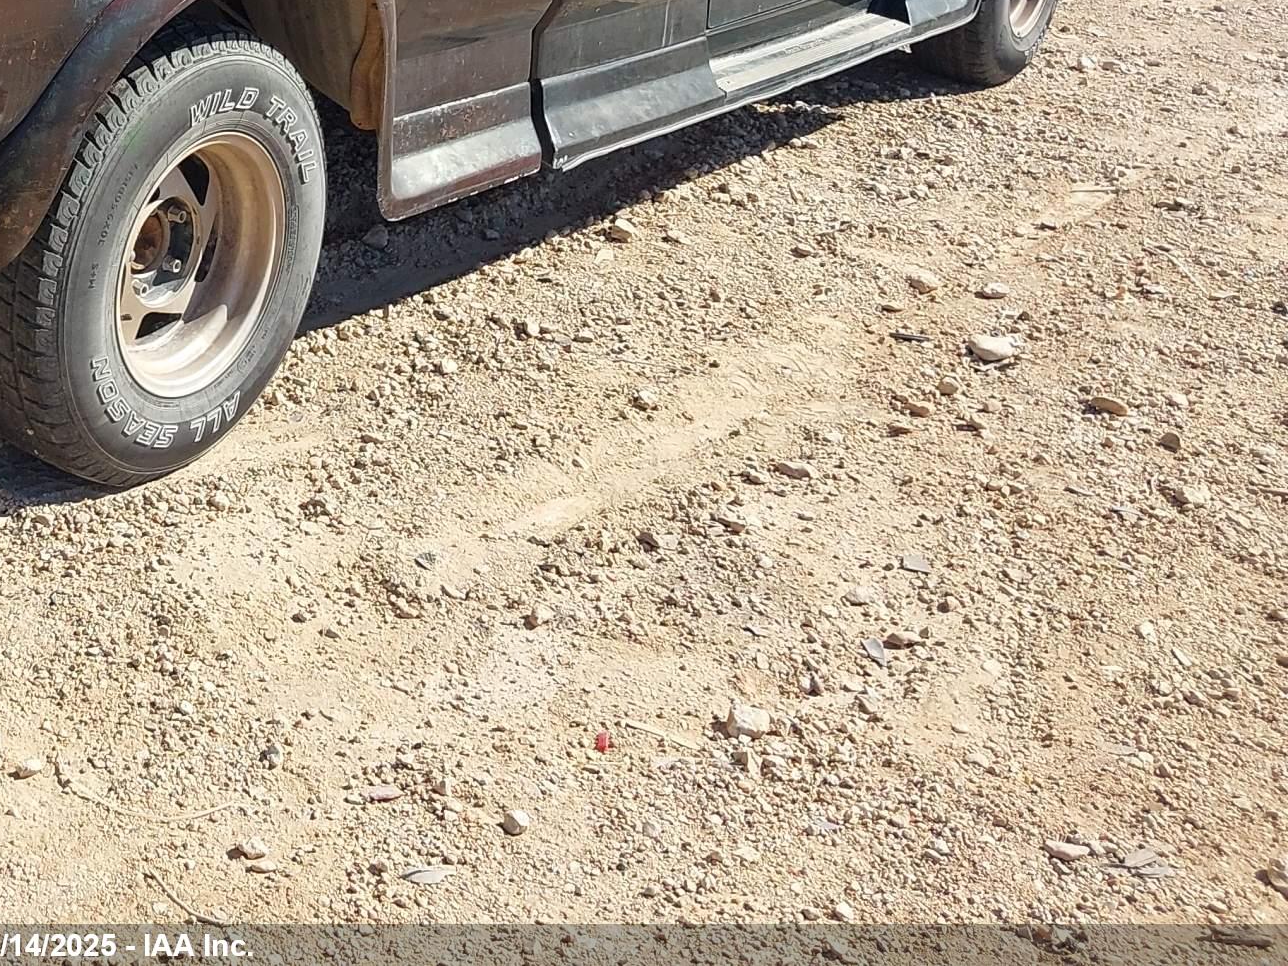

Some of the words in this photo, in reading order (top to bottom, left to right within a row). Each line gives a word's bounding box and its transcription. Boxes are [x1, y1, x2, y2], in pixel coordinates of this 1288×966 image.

[190, 87, 259, 127] WILD
[265, 95, 316, 184] TRAIL
[91, 356, 179, 449] SEASON
[190, 391, 241, 443] ALL
